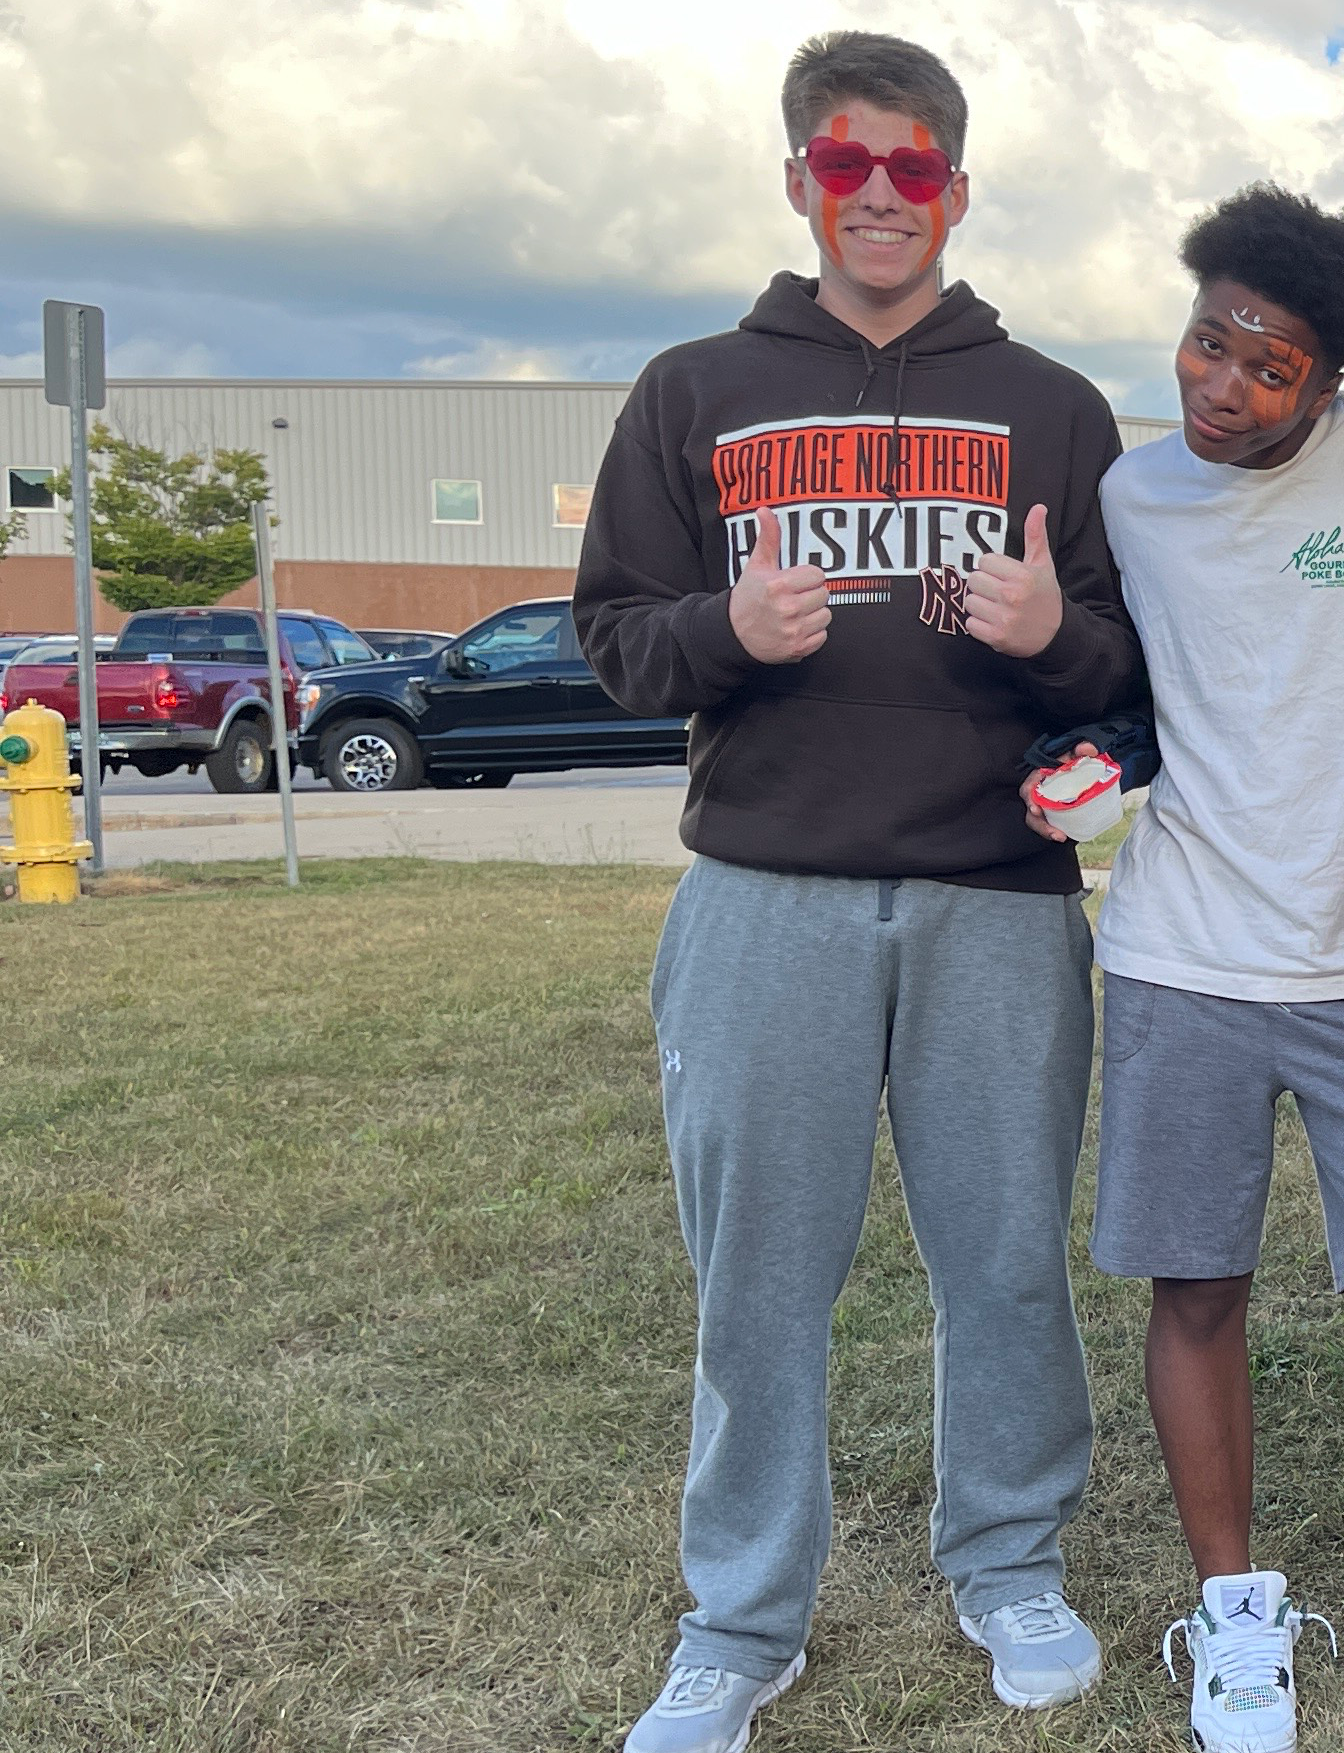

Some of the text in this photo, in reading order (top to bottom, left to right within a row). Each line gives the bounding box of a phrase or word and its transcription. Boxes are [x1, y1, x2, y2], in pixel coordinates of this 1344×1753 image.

[719, 431, 1004, 509] PORTAGE NORTHERN
[1301, 570, 1333, 581] POKE
